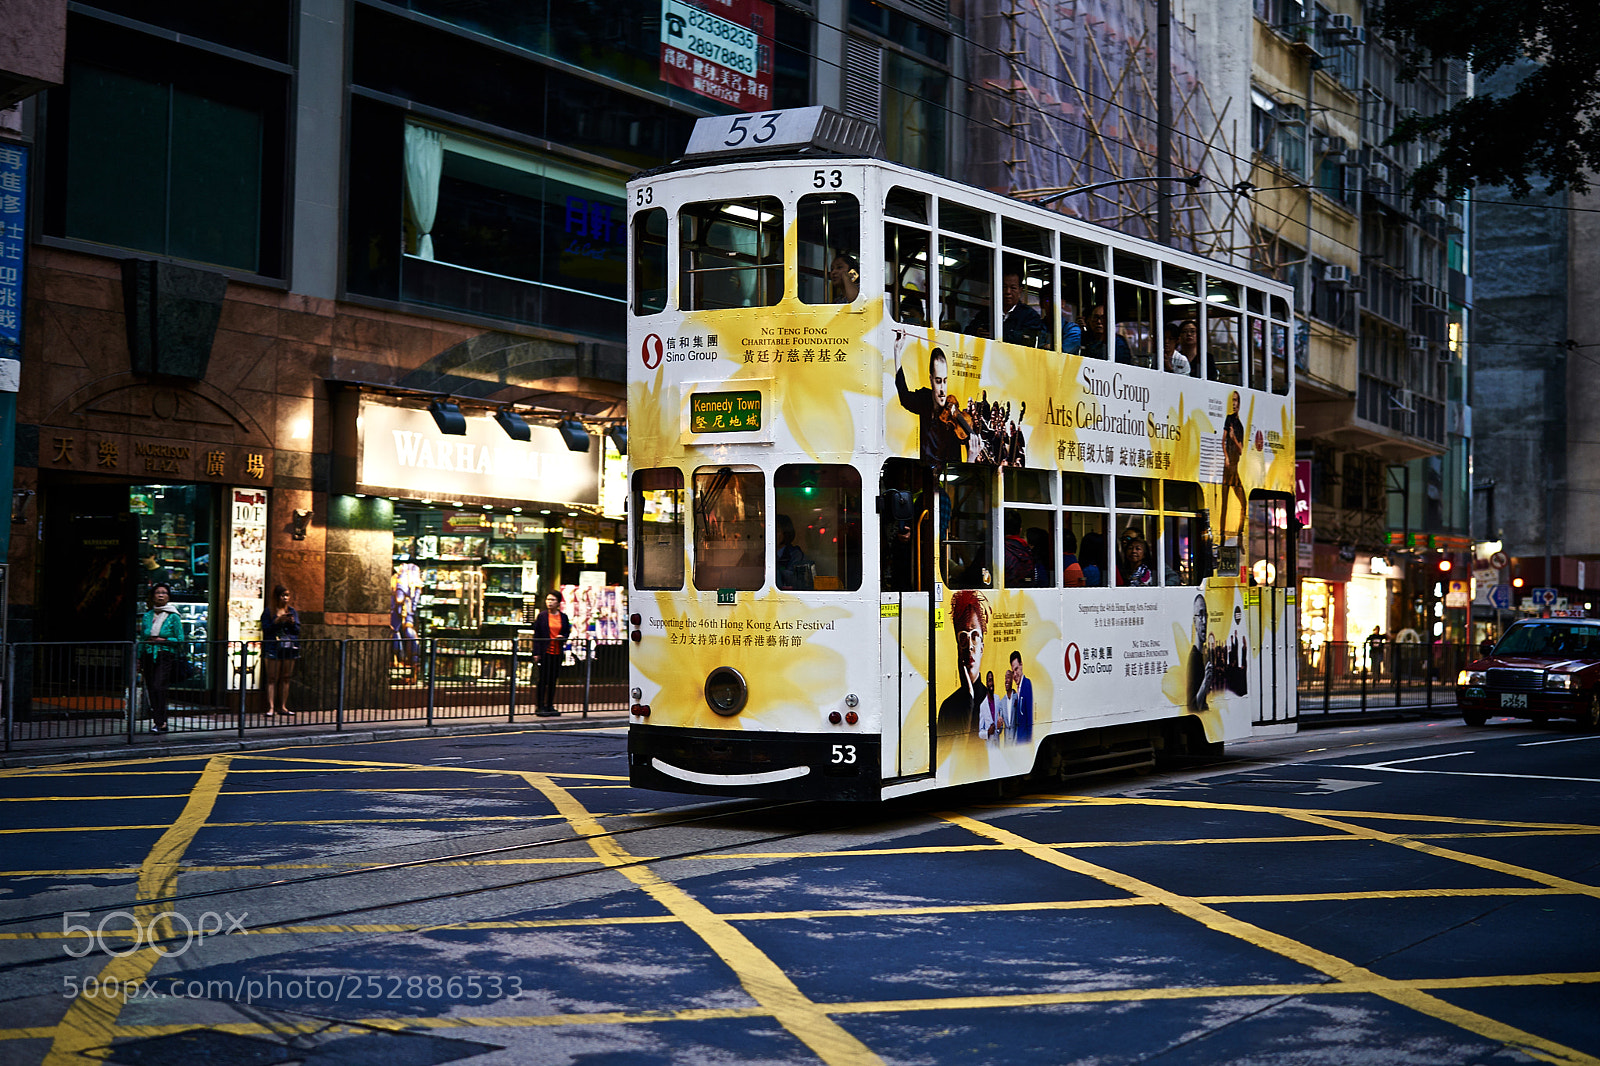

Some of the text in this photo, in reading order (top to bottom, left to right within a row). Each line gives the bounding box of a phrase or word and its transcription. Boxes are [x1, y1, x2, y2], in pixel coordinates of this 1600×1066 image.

[688, 10, 754, 49] 82338235
[688, 35, 753, 73] 28978883
[724, 112, 782, 147] 53
[813, 170, 843, 189] 53
[636, 187, 653, 206] 53
[761, 326, 828, 335] NG TENG FONG
[666, 334, 718, 350] 信和集團
[741, 336, 849, 346] CHARITABLE FOUNDATION
[666, 350, 718, 363] Sino Group
[743, 348, 848, 364] 黃廷方慈善基金
[1083, 366, 1150, 412] Sino Group
[694, 397, 760, 414] Kennedy Town
[695, 413, 759, 429] 堅尼地城
[1044, 397, 1182, 442] Arts Celebration Series
[135, 442, 191, 460] MORRISON
[144, 457, 181, 474] PLAZA
[236, 505, 263, 521] 10/F
[649, 616, 835, 632] Supporting the 46th Hong Kong Arts Festival
[670, 633, 802, 647] 全力支持第46屆香港藝術節
[1083, 646, 1113, 660] 信和集團
[1083, 662, 1113, 675] Sino Group
[831, 745, 857, 764] 53
